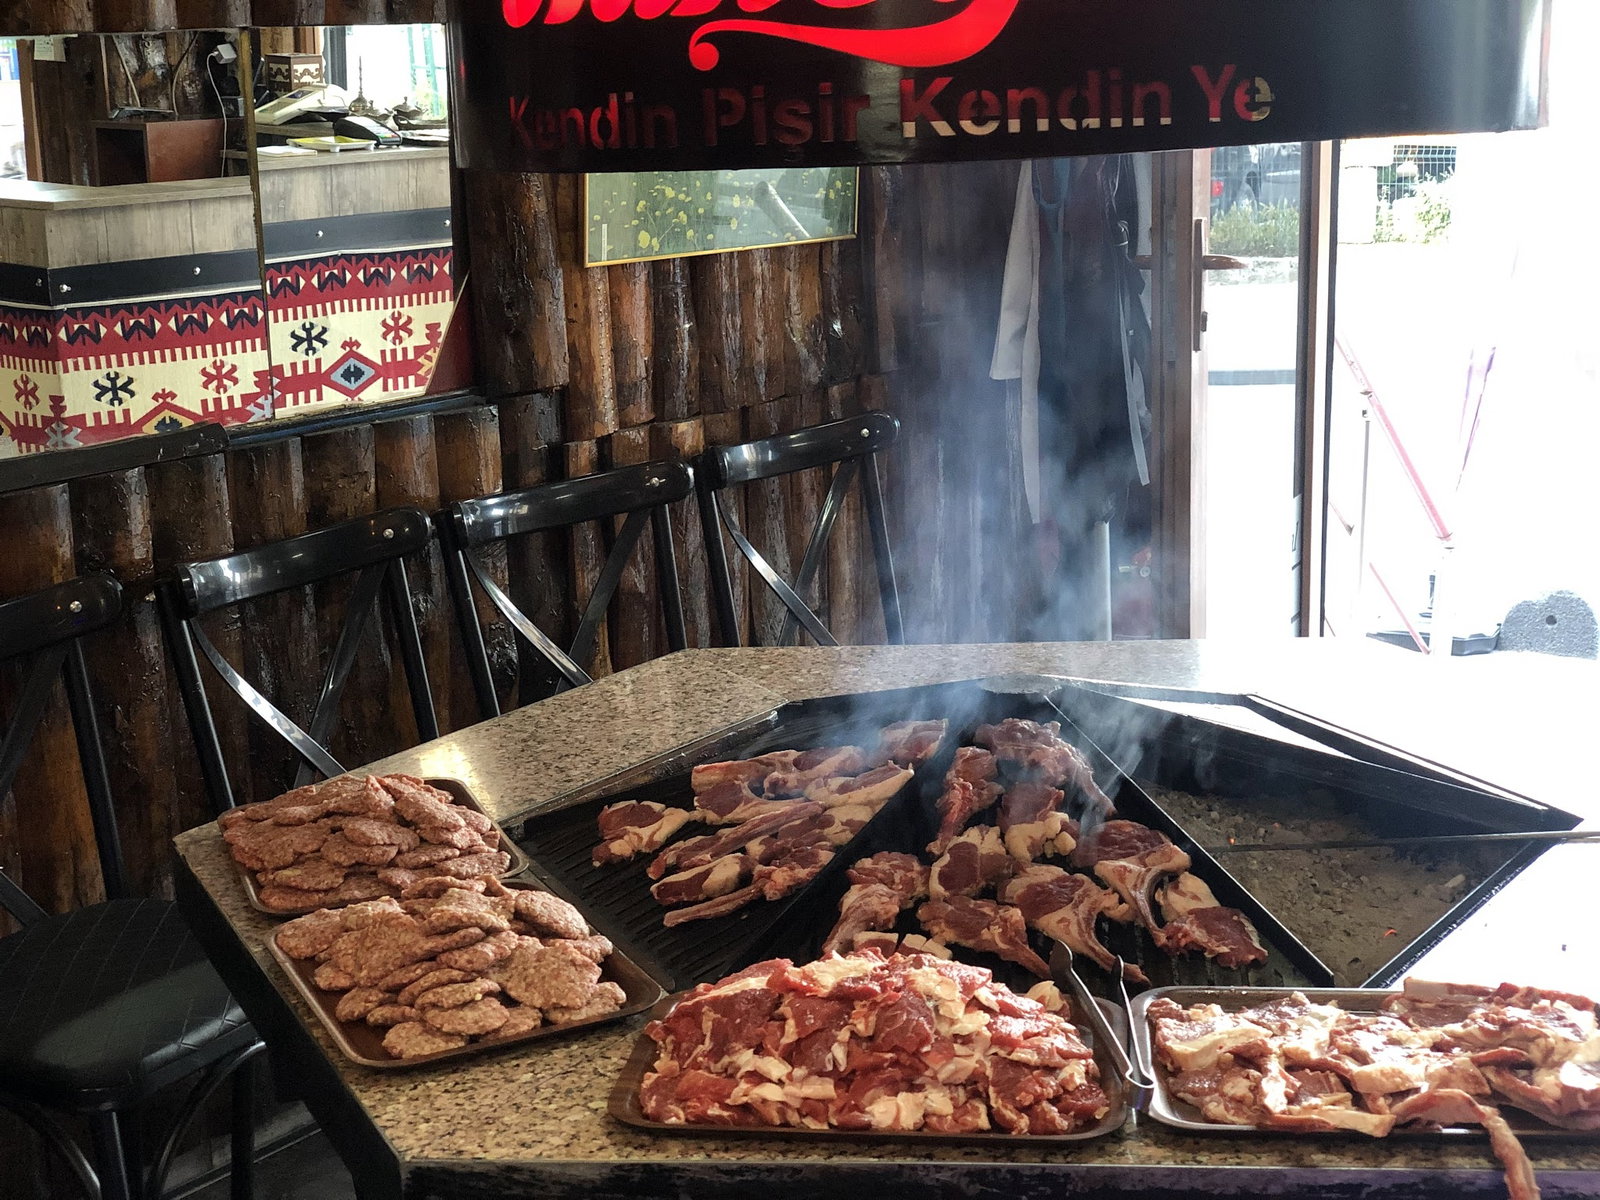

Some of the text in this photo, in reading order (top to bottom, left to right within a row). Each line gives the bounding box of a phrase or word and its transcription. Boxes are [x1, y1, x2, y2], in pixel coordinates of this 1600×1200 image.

[508, 91, 679, 151] Kendin
[900, 67, 1172, 139] Kendin
[1191, 64, 1275, 123] Ye
